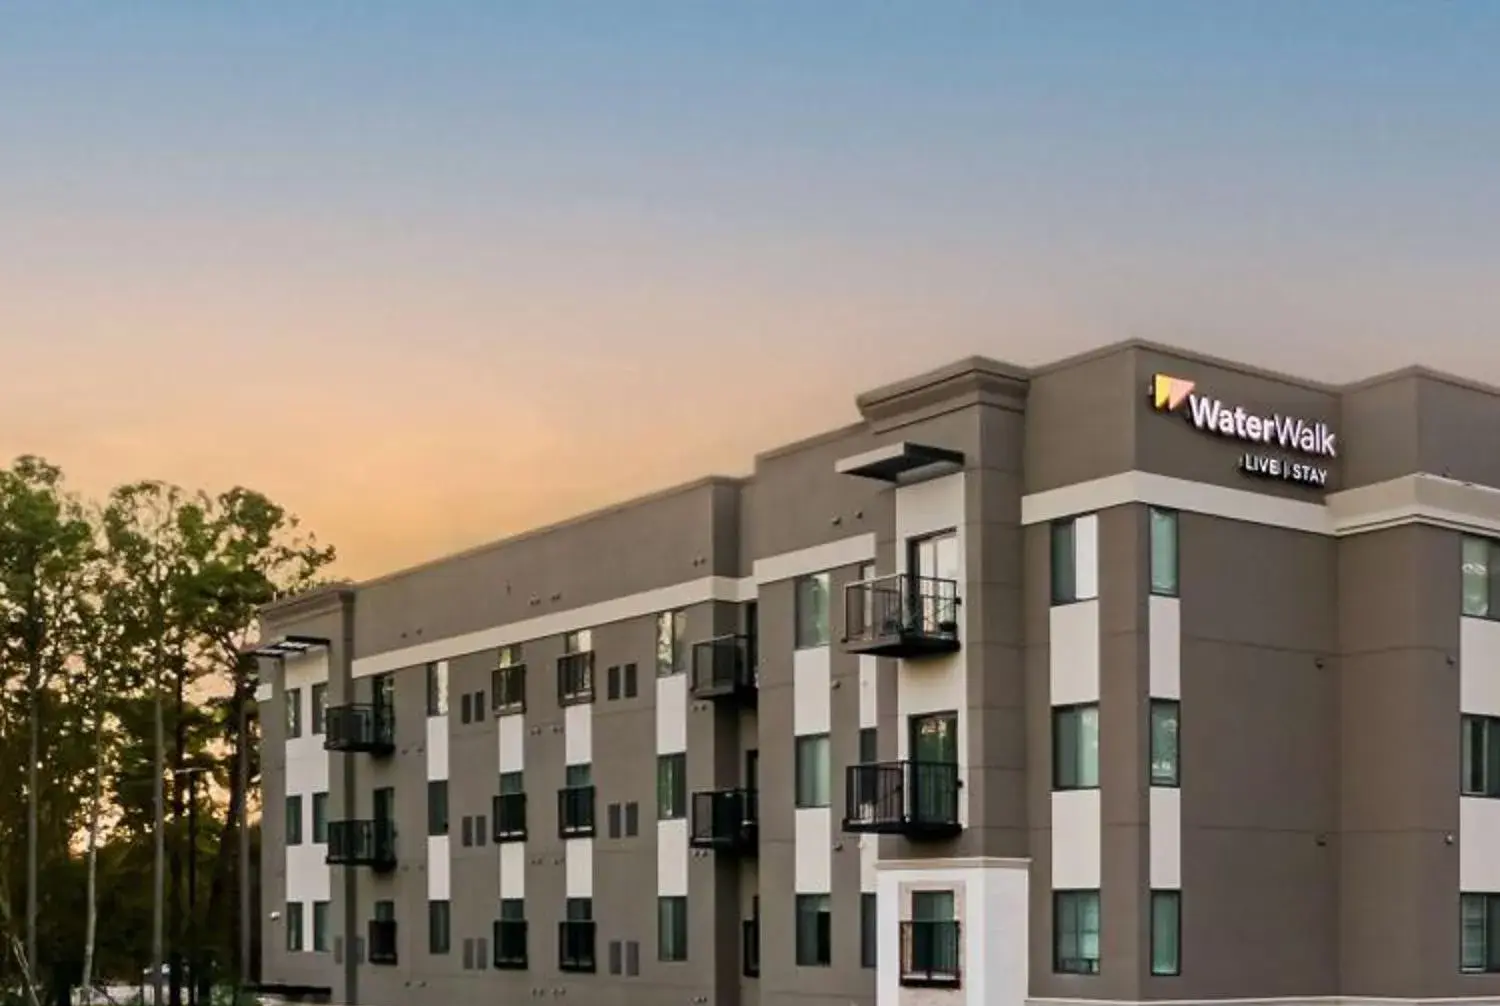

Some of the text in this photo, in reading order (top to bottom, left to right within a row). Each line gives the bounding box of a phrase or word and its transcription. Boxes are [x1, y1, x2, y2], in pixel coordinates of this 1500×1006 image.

[1189, 394, 1336, 457] WaterWalk
[1245, 453, 1327, 484] LIVE STAY
